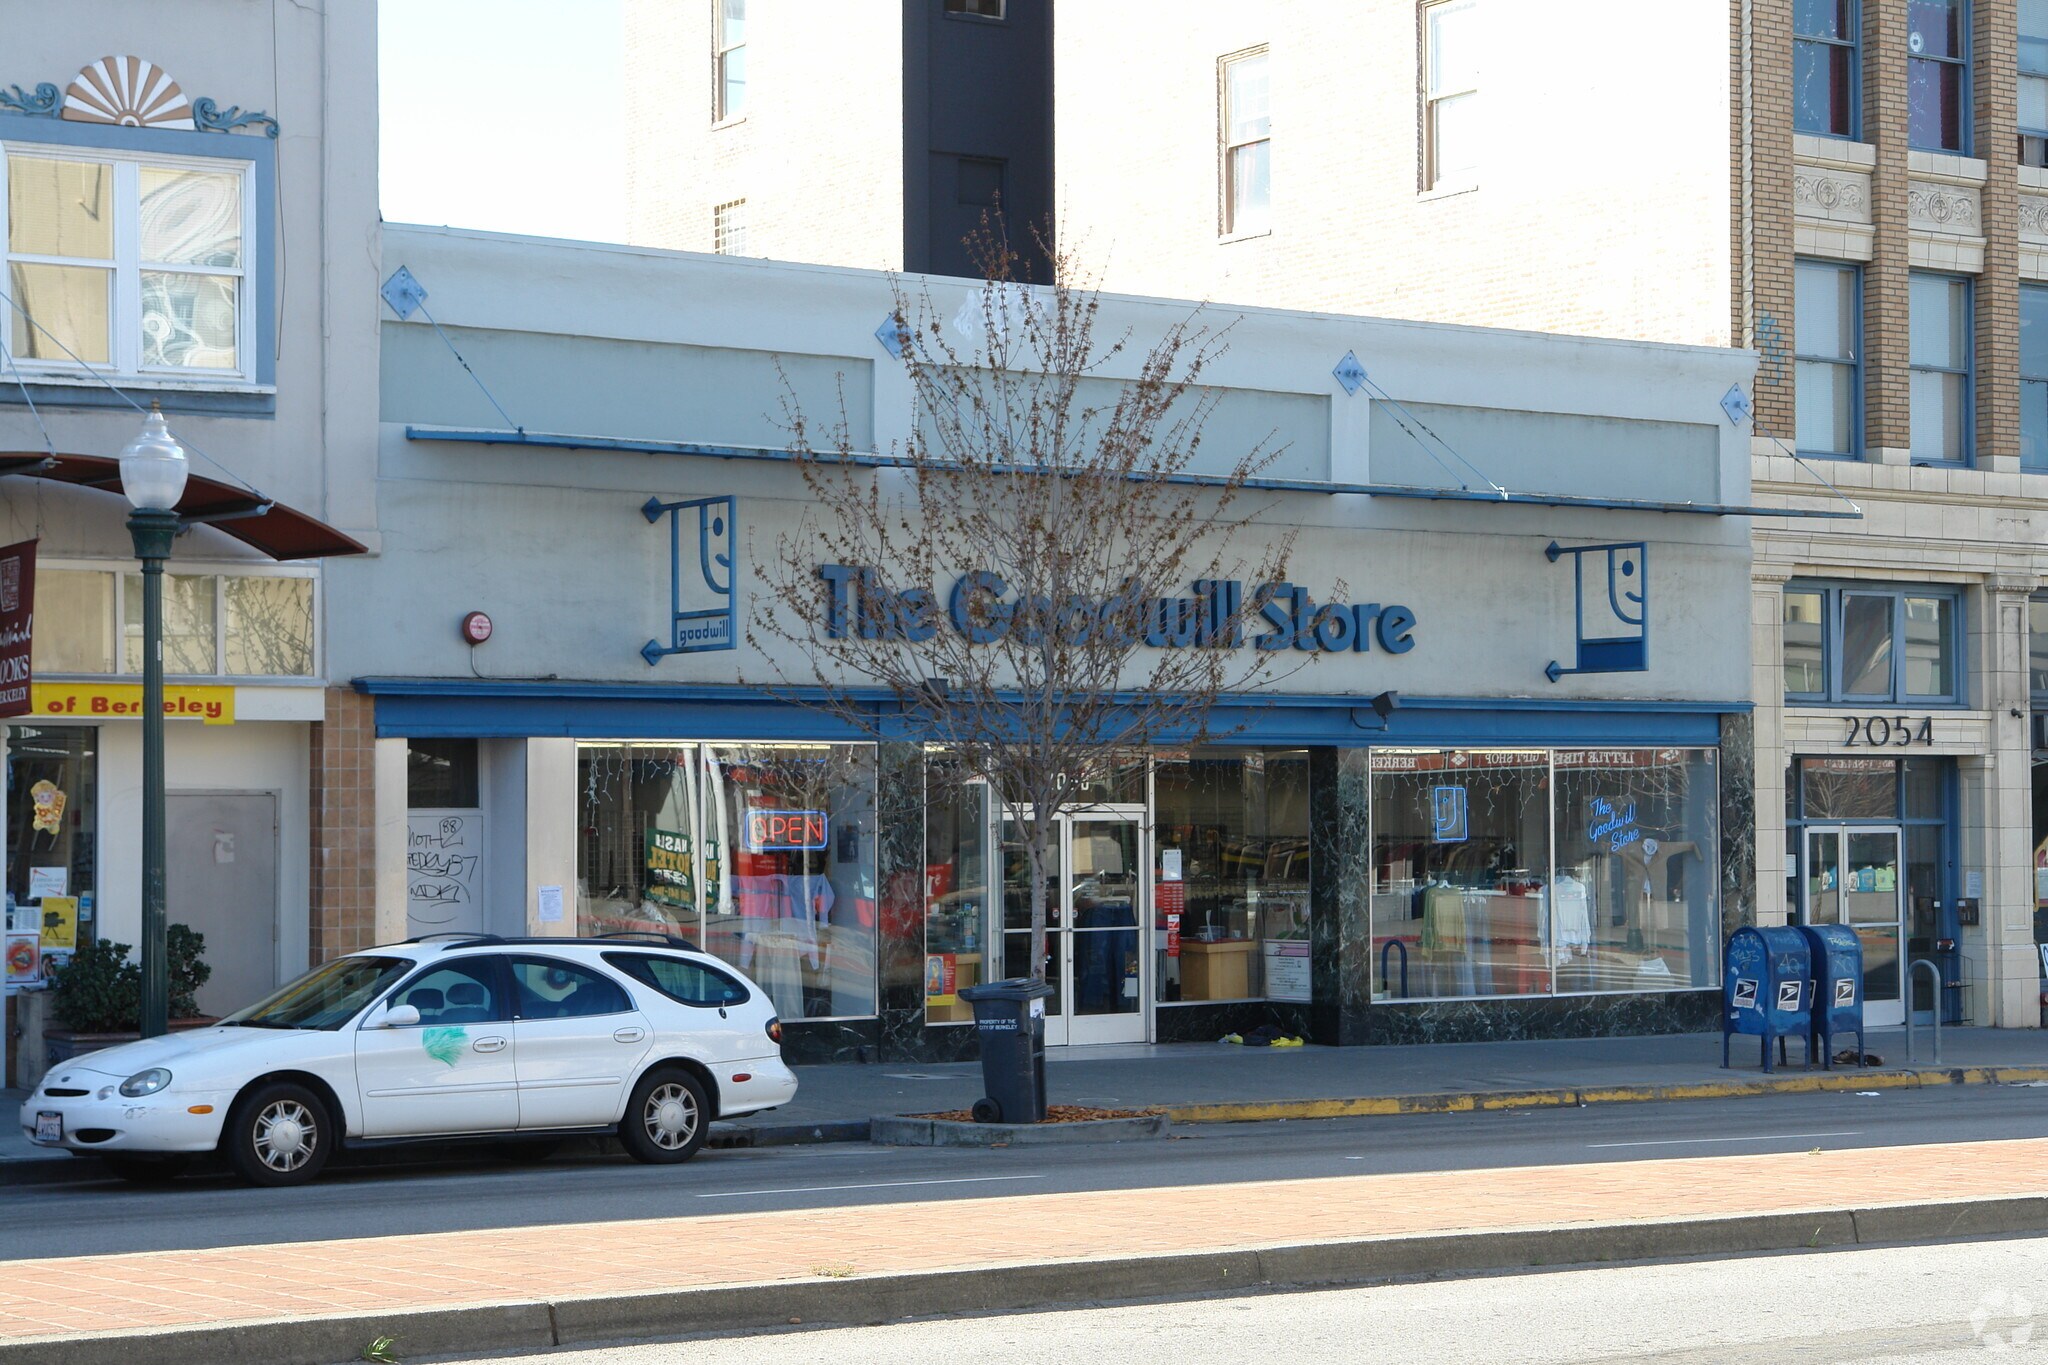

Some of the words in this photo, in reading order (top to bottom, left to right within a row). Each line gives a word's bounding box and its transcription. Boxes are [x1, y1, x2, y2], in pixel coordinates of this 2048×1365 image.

[820, 564, 938, 642] The
[950, 571, 1242, 648] Goodwill
[1255, 582, 1417, 654] Store
[680, 619, 729, 647] goodwill
[47, 696, 76, 713] of
[91, 696, 222, 718] Bereley
[1842, 716, 1935, 747] 2054
[1590, 797, 1612, 817] The
[752, 817, 823, 843] OPEN
[1611, 829, 1640, 852] Store
